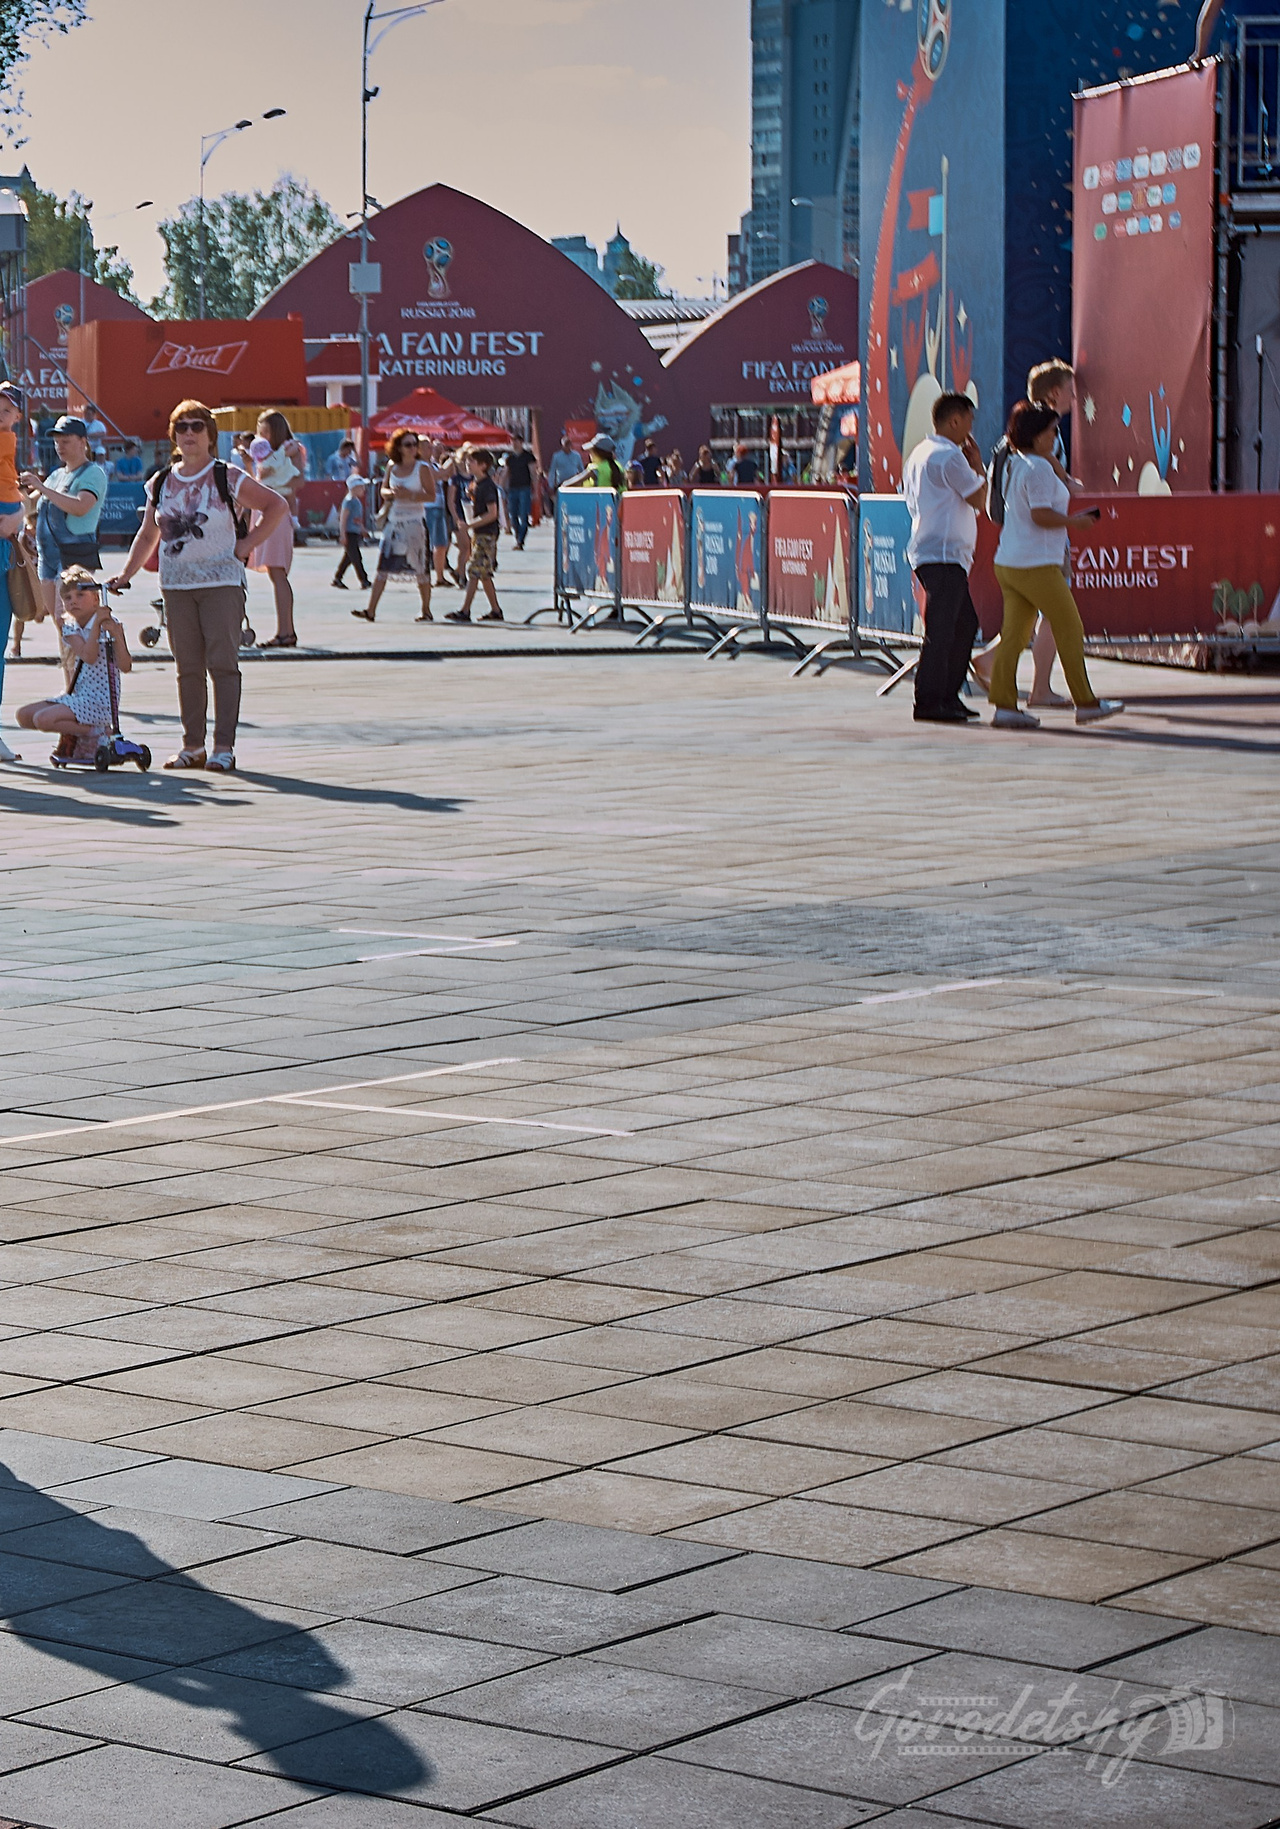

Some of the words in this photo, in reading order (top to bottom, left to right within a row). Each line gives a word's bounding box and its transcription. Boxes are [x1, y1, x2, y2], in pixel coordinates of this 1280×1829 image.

[401, 331, 464, 356] FAN
[470, 331, 544, 356] FEST
[164, 345, 223, 369] Bud
[378, 359, 506, 376] KATERINBURG
[741, 361, 787, 380] FIFA
[1127, 545, 1194, 570] FEST
[1072, 571, 1158, 589] ERINBURG
